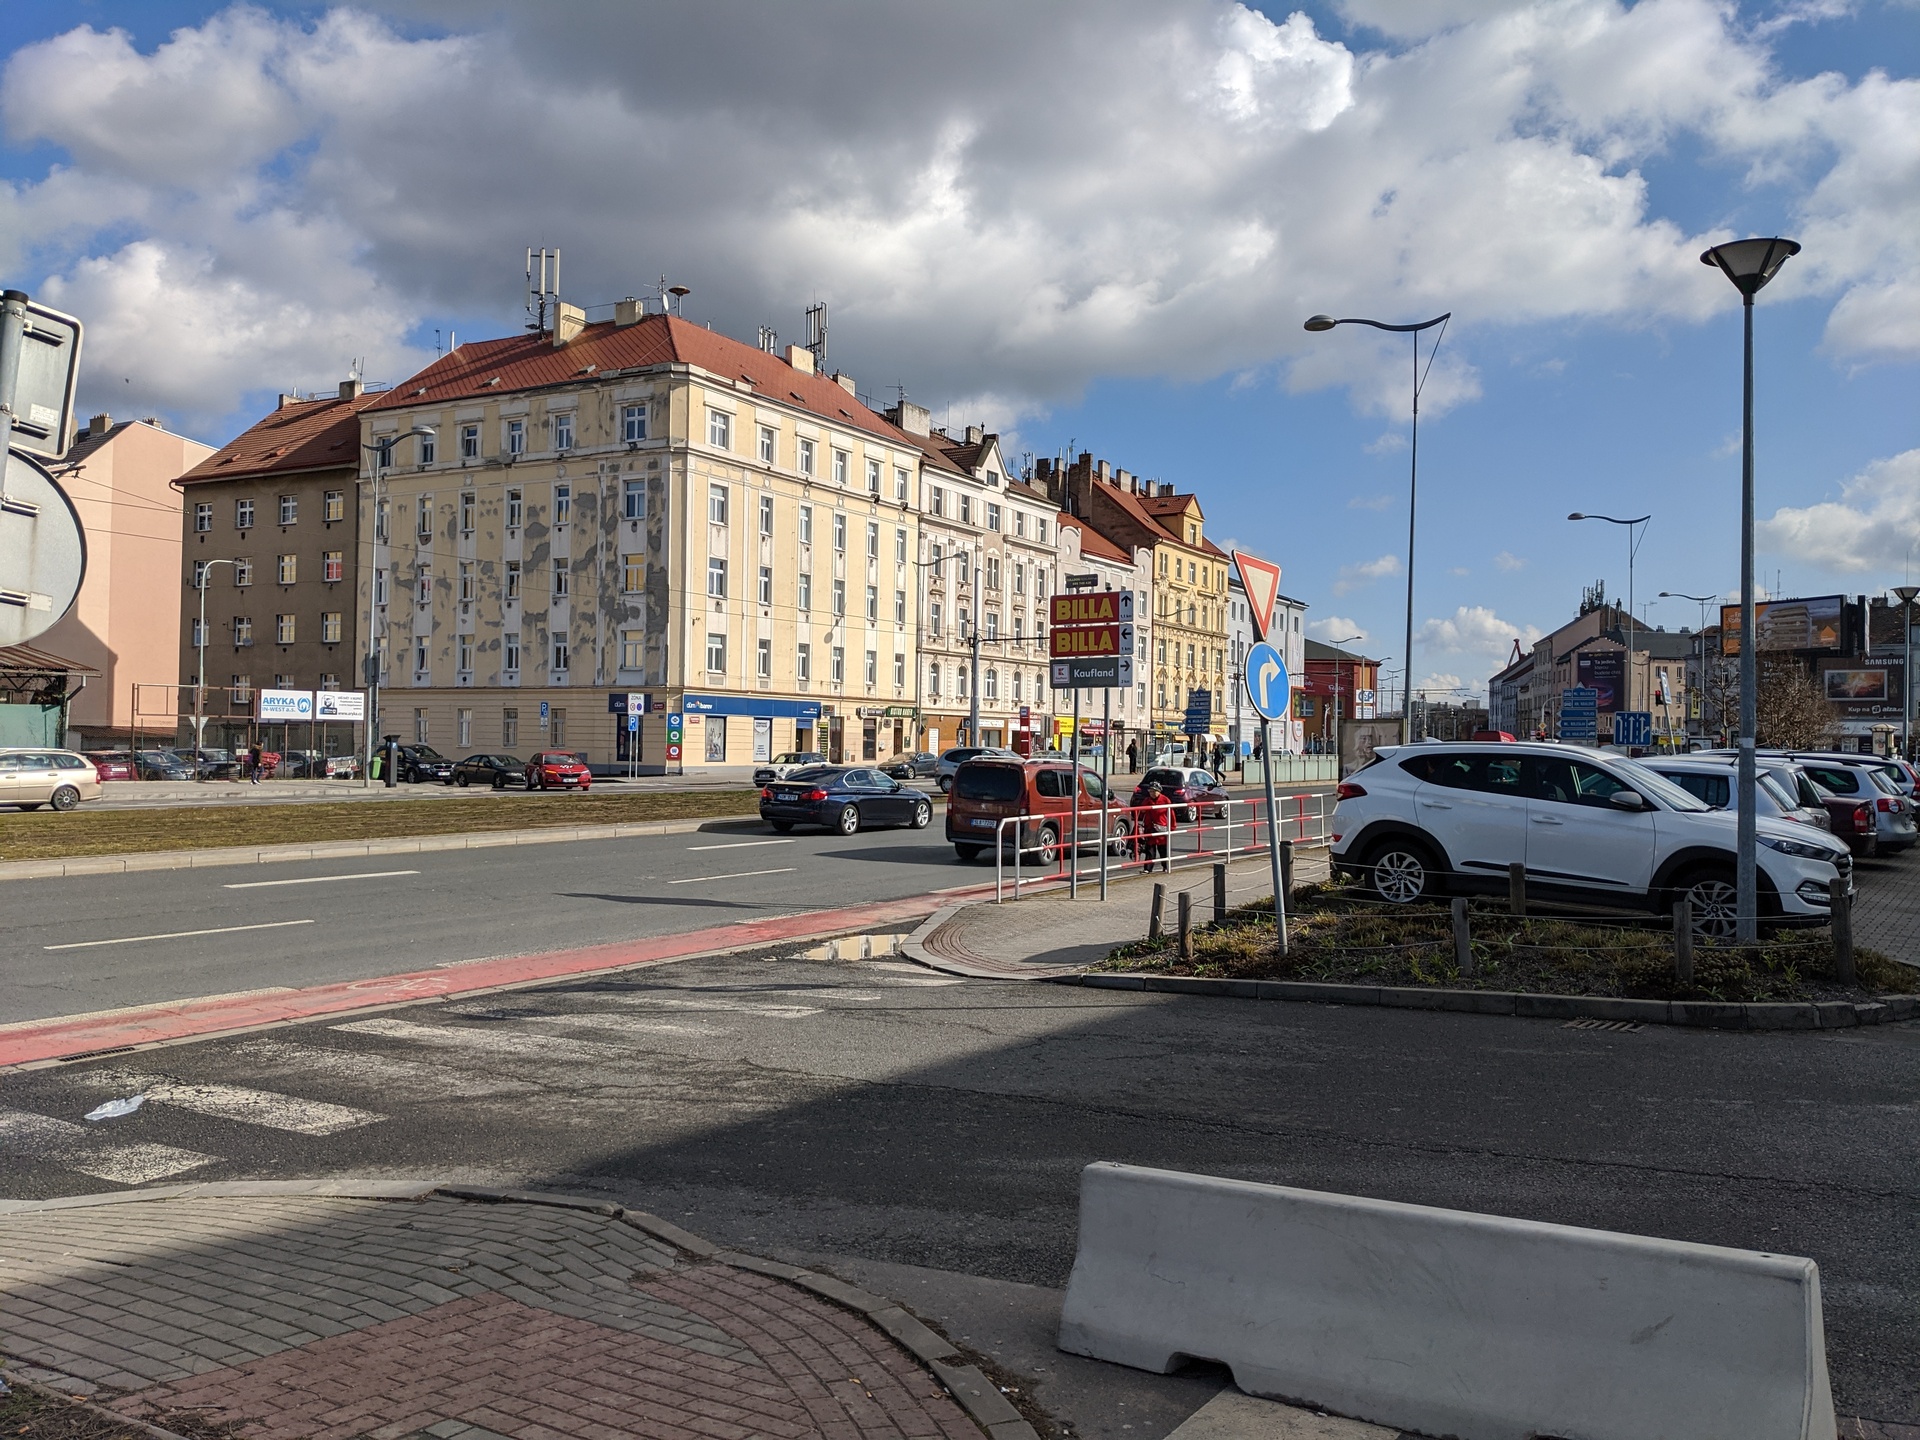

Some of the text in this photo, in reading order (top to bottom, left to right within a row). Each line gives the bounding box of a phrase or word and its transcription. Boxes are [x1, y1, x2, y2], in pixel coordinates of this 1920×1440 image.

[1056, 598, 1114, 620] BILLA
[1056, 630, 1114, 653] BILLA
[1865, 658, 1904, 666] SAMSUNG
[1073, 667, 1114, 678] Kaufland
[263, 697, 295, 705] ARYKA
